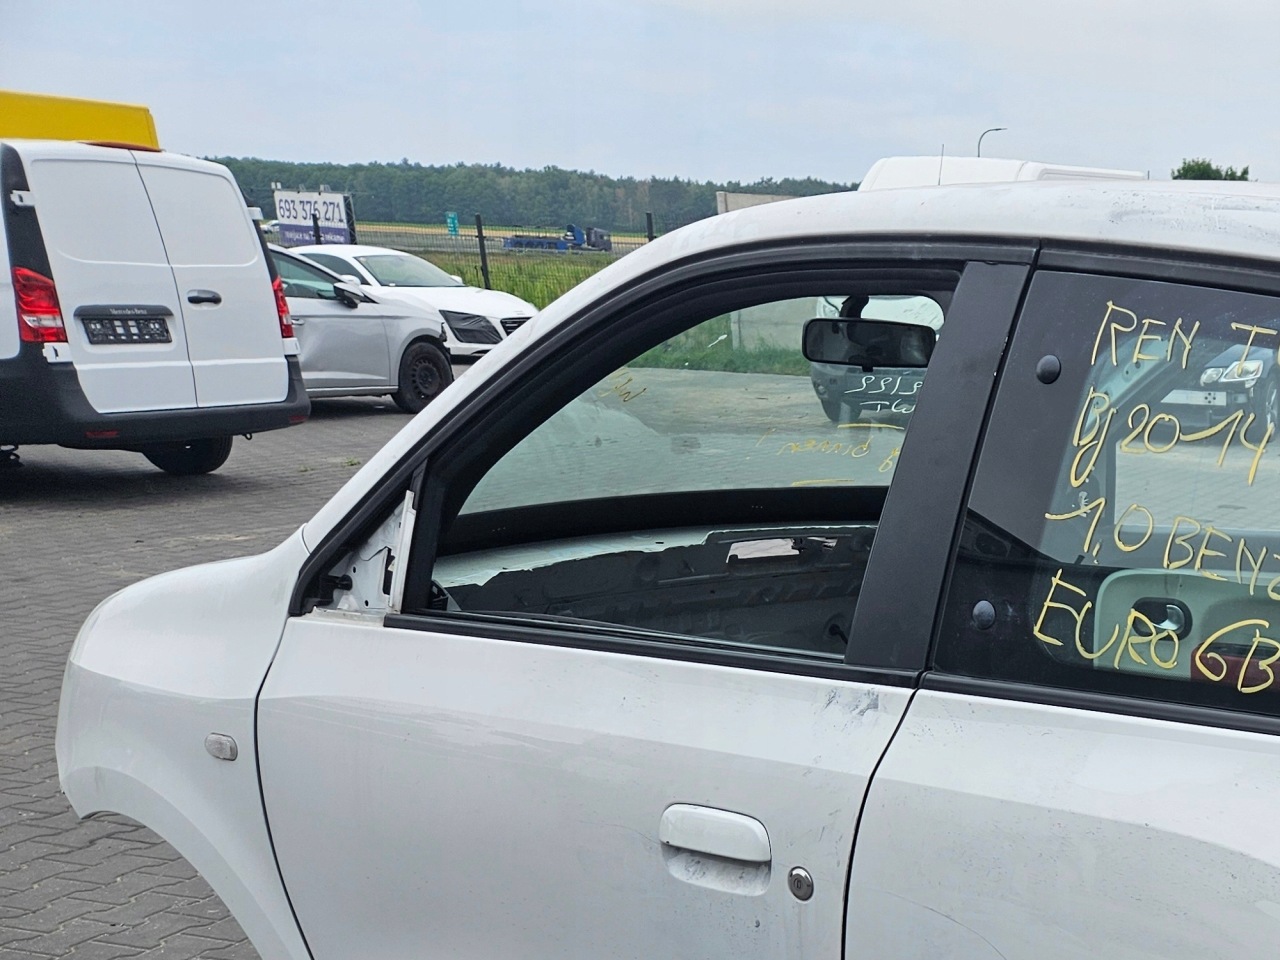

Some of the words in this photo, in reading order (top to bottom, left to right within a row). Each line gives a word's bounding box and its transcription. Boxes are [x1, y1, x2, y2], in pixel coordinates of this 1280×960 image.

[278, 199, 298, 220] 693
[300, 201, 320, 220] 376
[323, 201, 344, 222] 271
[1091, 300, 1200, 369] REN
